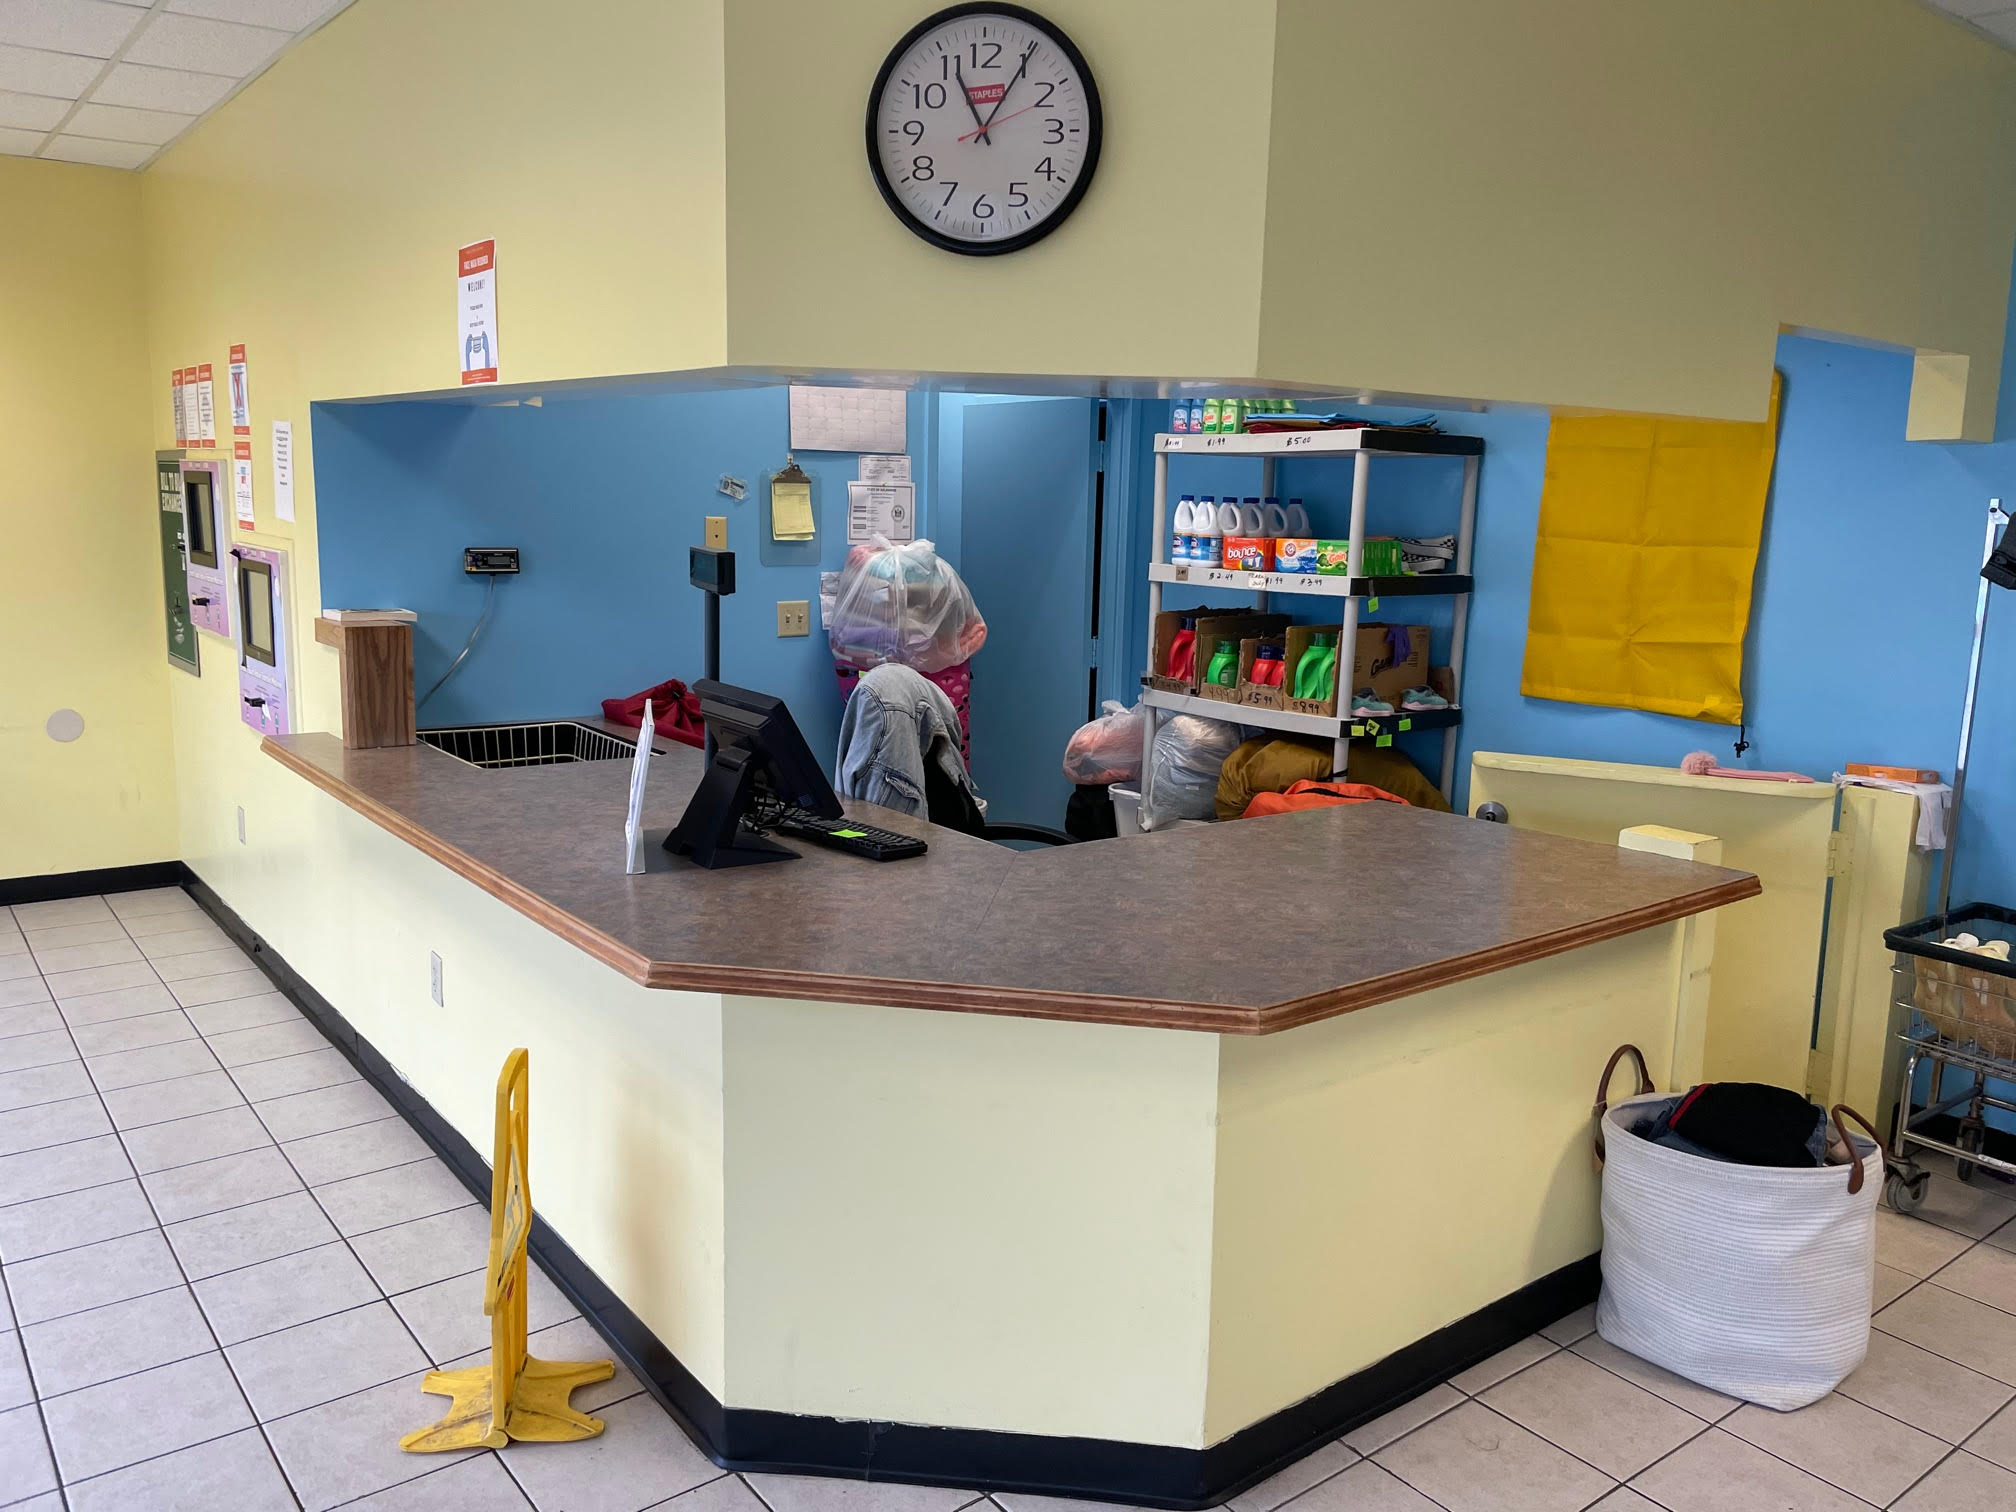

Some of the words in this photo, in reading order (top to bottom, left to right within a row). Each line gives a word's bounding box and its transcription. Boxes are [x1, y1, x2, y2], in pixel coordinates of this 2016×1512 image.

[941, 55, 961, 80] 11
[970, 43, 1002, 69] 12
[1019, 53, 1027, 79] 1
[913, 83, 946, 109] 10
[969, 88, 1003, 99] STAPLES
[1034, 82, 1055, 107] 2
[903, 120, 924, 146] 9
[1043, 119, 1065, 144] 3
[912, 156, 934, 181] 8
[1034, 157, 1056, 181] 4
[940, 182, 959, 207] 7
[973, 194, 994, 219] 6
[1008, 183, 1029, 207] 5
[1228, 547, 1256, 559] bounce
[1328, 552, 1346, 563] Gain
